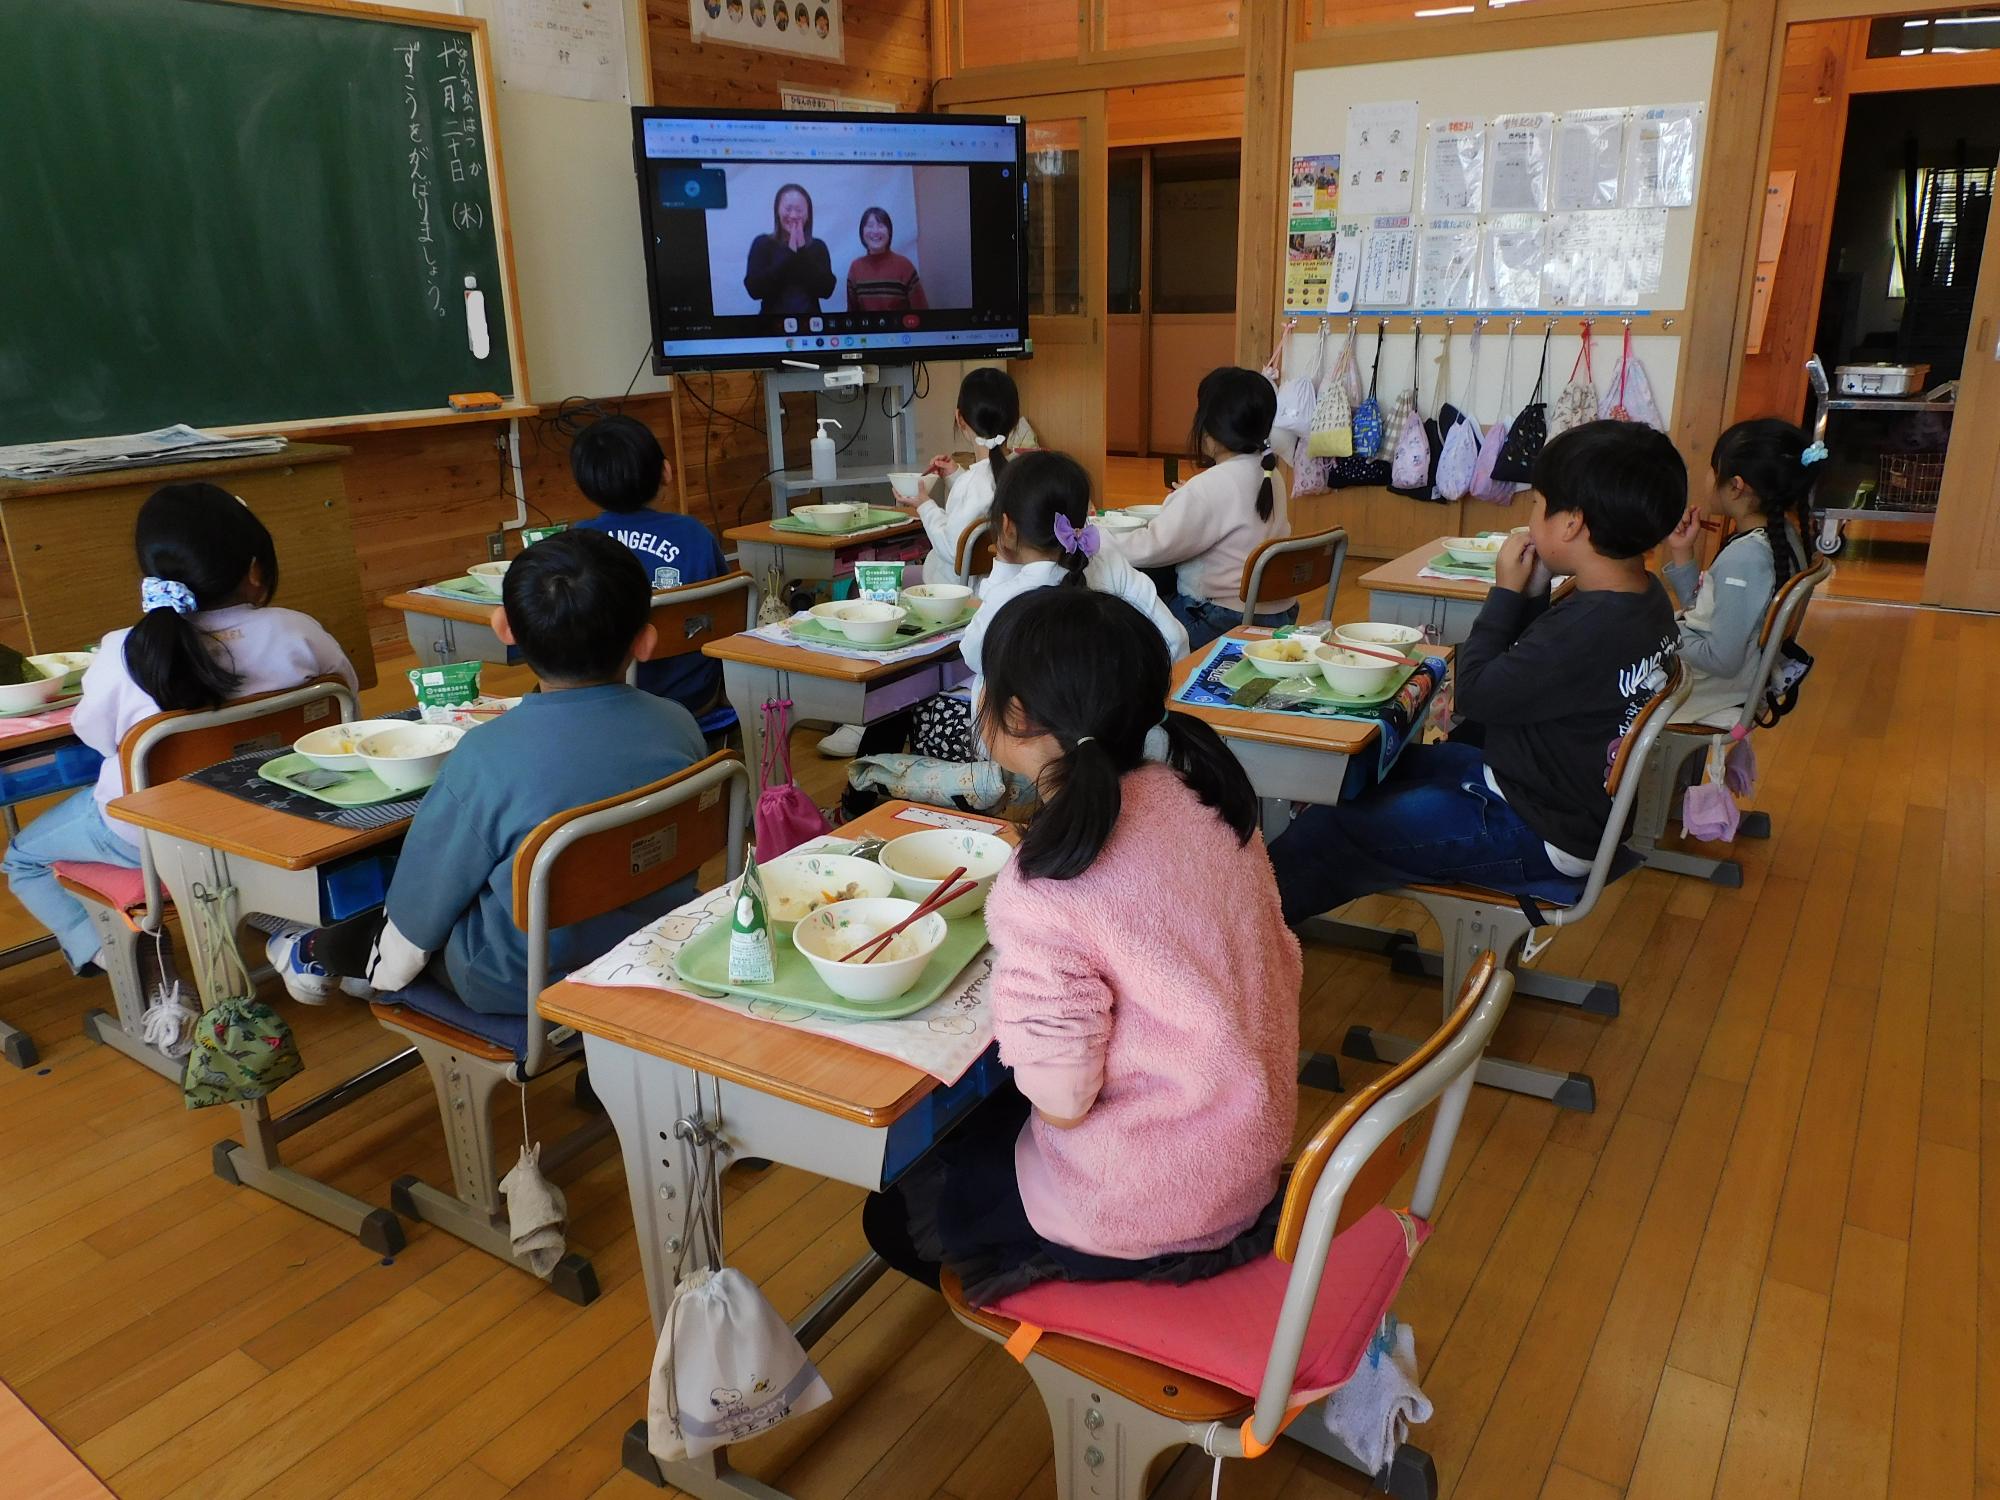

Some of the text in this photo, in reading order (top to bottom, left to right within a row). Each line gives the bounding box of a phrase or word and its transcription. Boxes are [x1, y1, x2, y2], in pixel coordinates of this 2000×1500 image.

[393, 40, 446, 317] ずこうをがんばりましょう。
[607, 529, 681, 564] NGELES
[715, 1393, 787, 1433] SNOOPY
